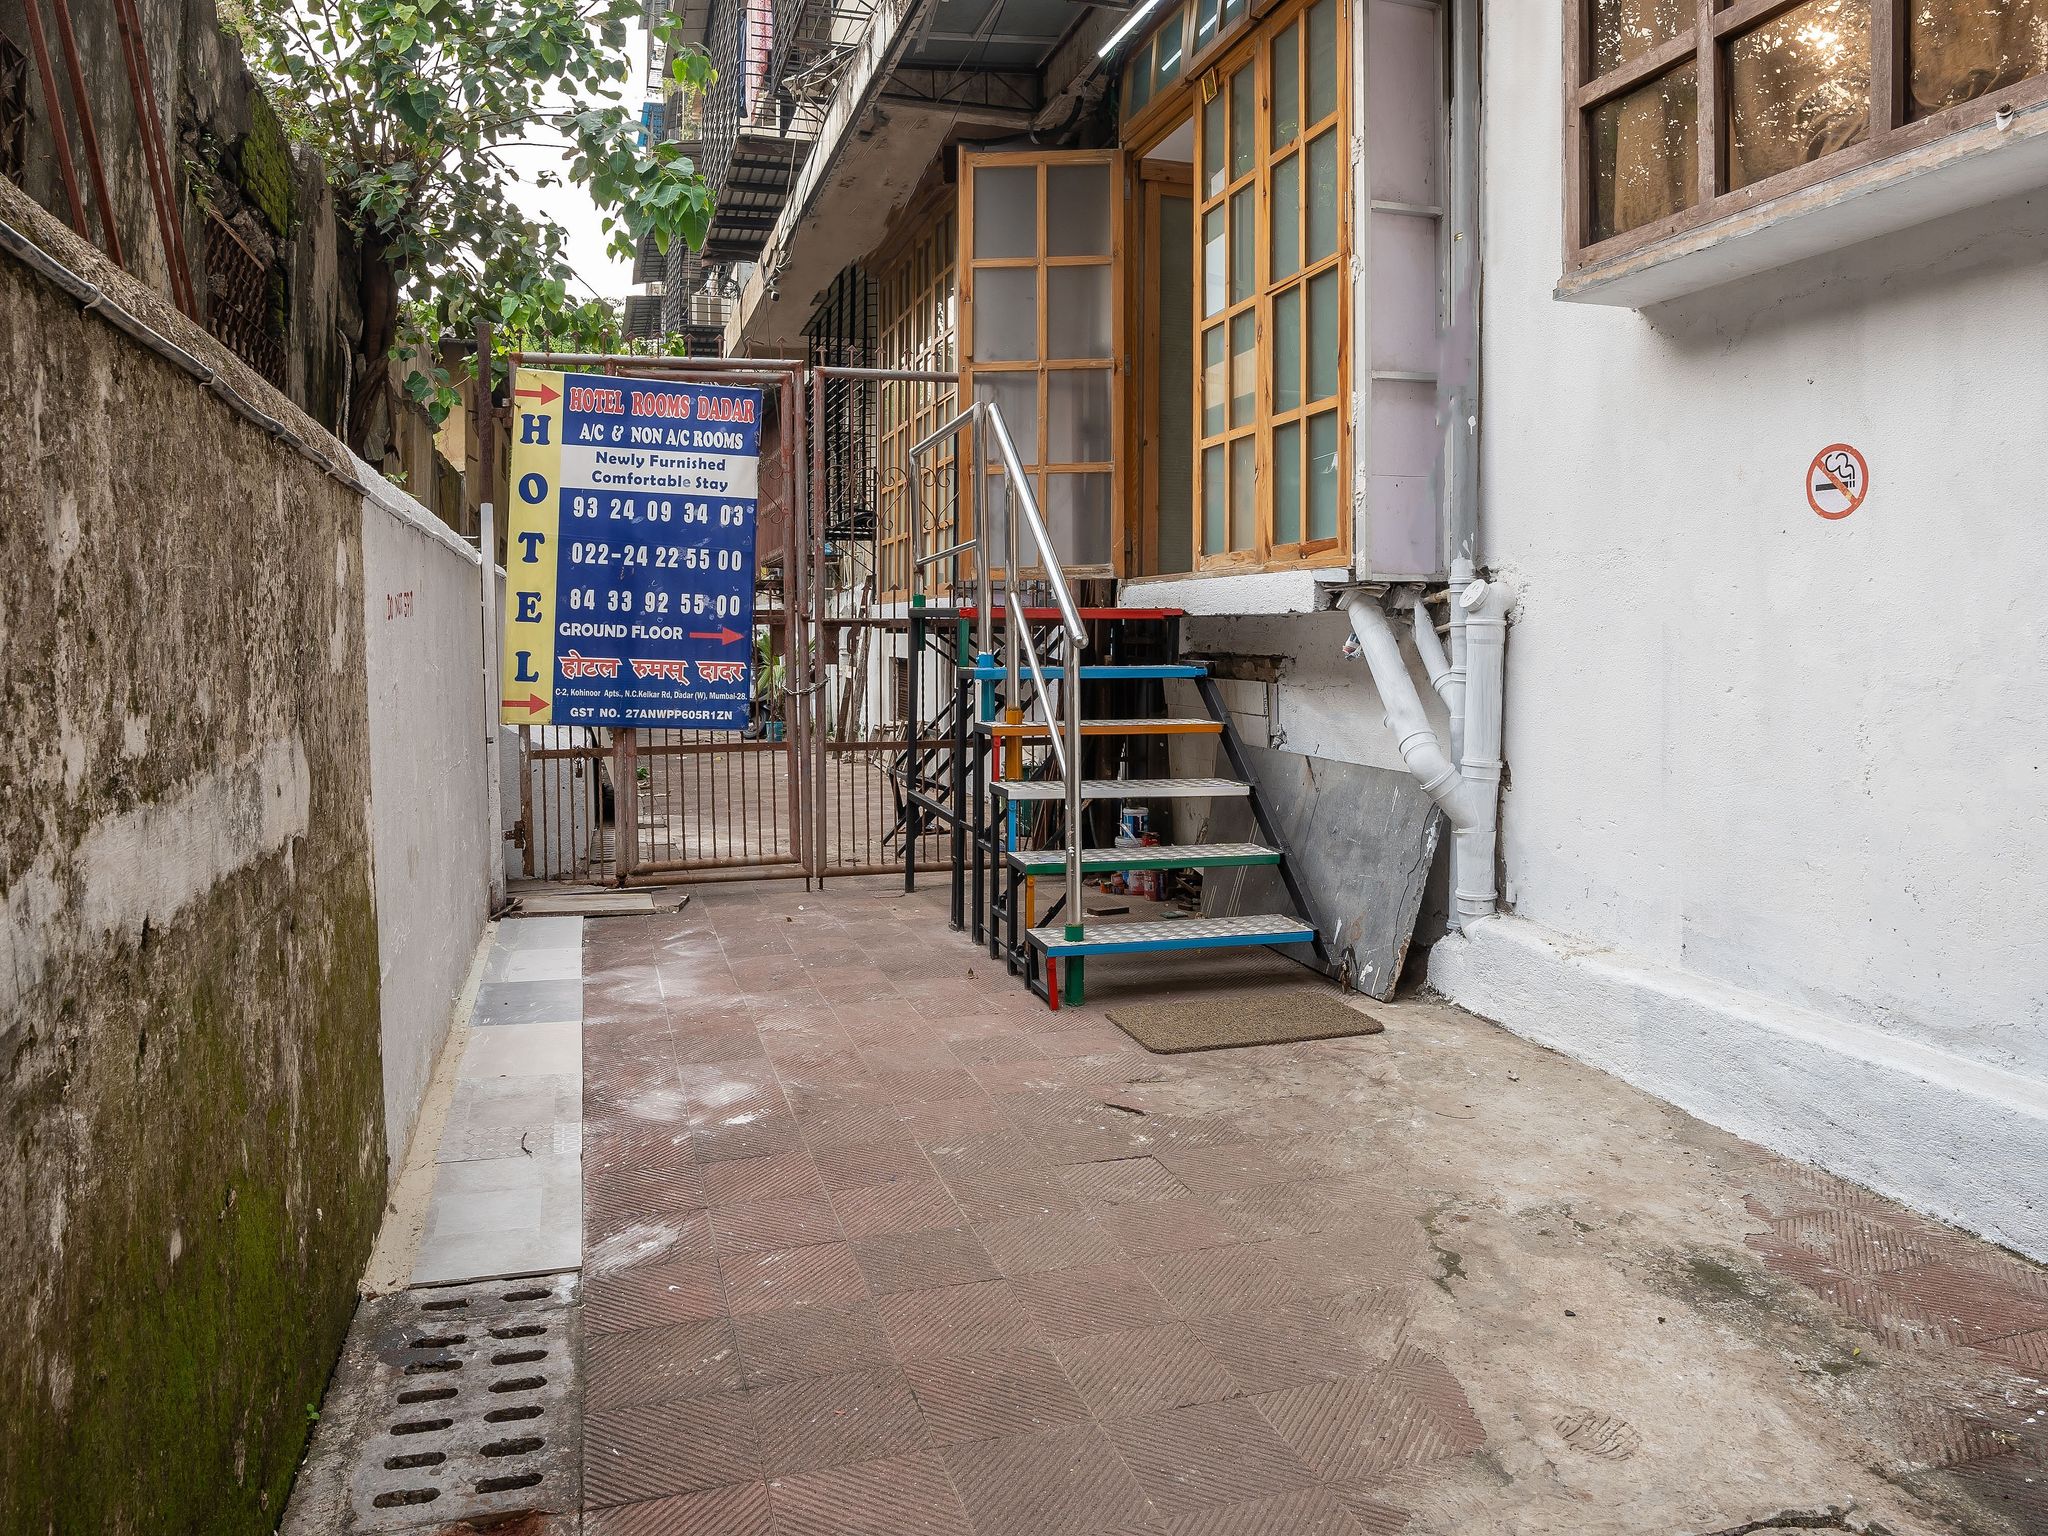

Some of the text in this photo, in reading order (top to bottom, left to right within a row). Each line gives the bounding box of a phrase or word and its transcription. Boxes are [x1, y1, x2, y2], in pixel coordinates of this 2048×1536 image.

[569, 387, 755, 423] HOTEL ROOMS DADAR
[579, 423, 743, 450] A/C & NON A/C ROOMS
[595, 451, 726, 471] Newly Furnished
[591, 470, 728, 491] Comfortable Stay
[573, 496, 743, 526] 93 24 09 34 03
[514, 413, 551, 683] HOTEL
[571, 542, 742, 571] 022-24 22 55 00
[570, 588, 740, 616] 84 33 92 55 00
[559, 623, 683, 640] GROUND FLOOR
[558, 649, 622, 680] होटल
[695, 660, 747, 684] दादर
[555, 688, 569, 698] C-2,
[570, 688, 600, 697] Kohinoor
[661, 691, 673, 699] Rd,
[673, 691, 694, 699] Dadar
[570, 707, 733, 720] GST NO. 27ANWPP605R1ZN
